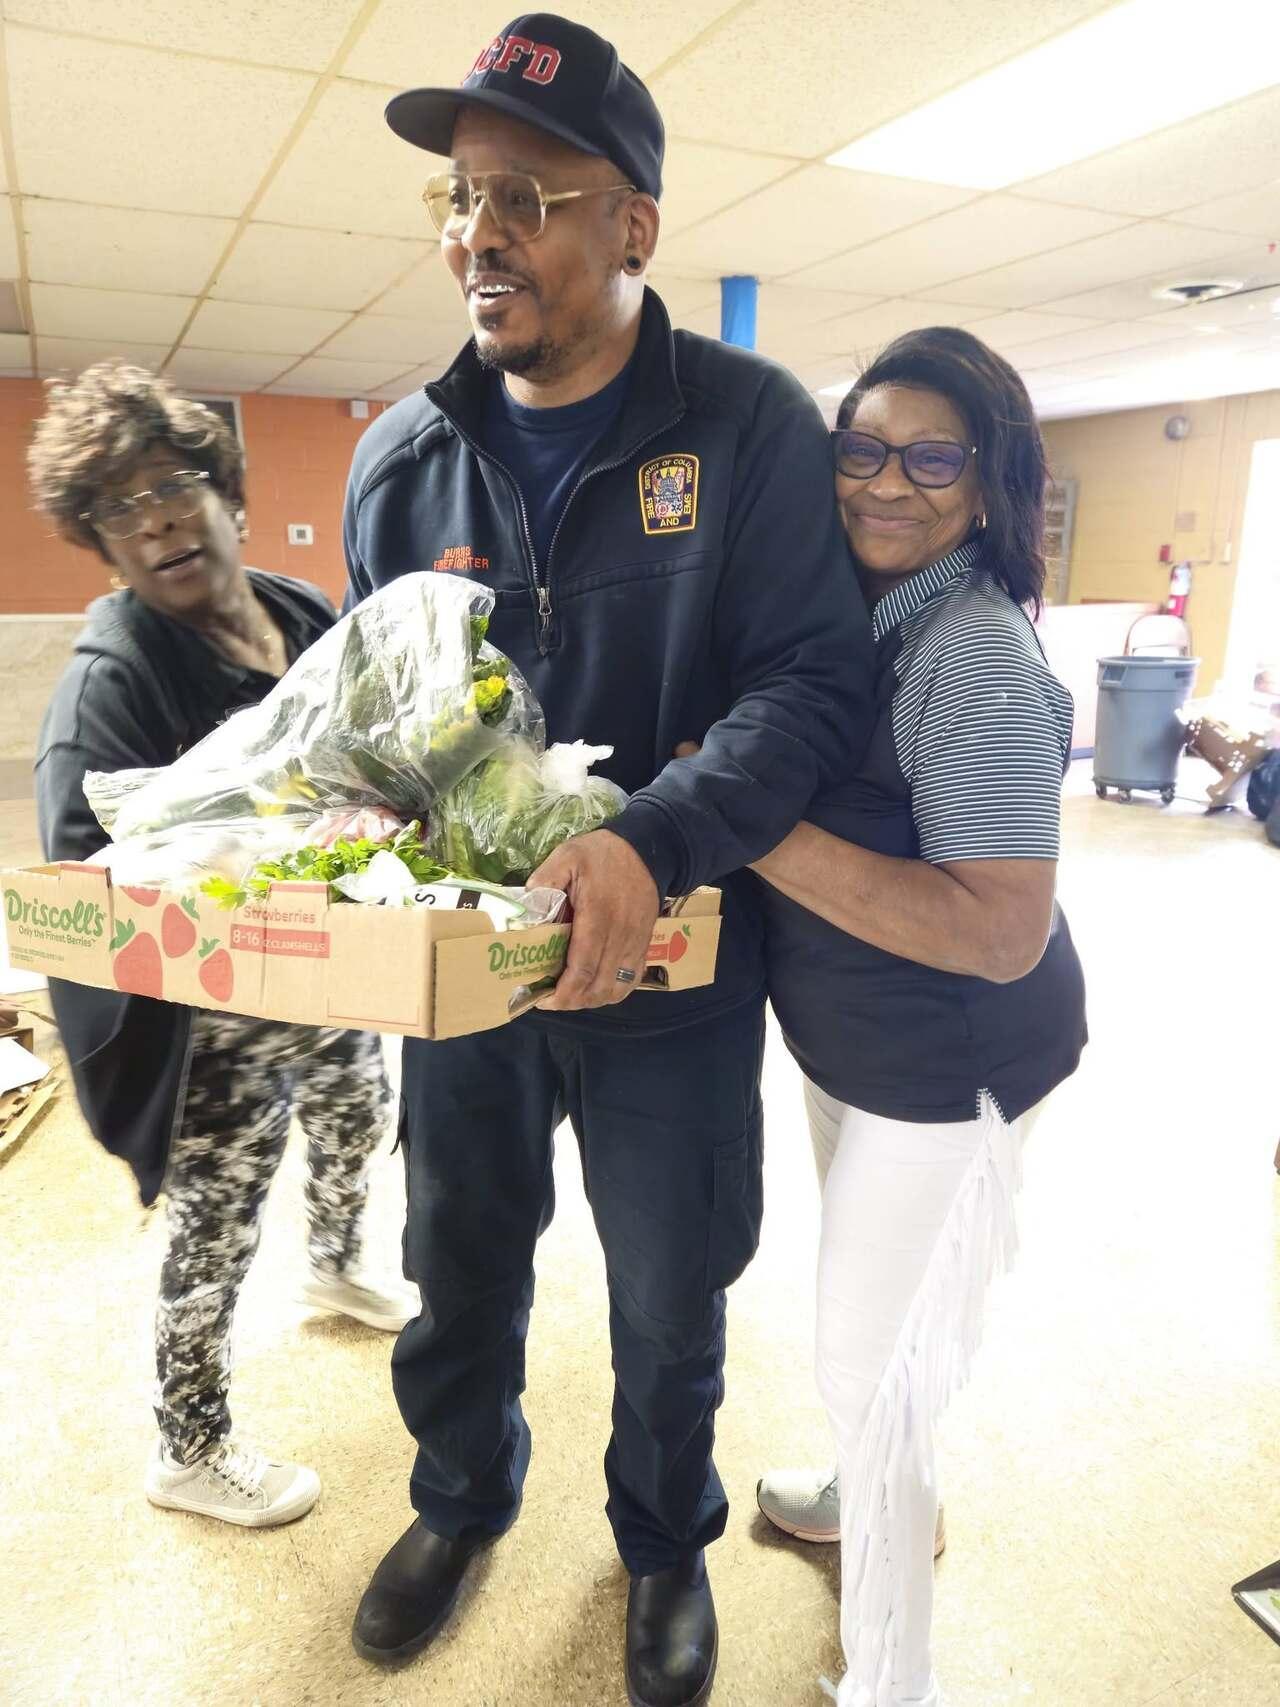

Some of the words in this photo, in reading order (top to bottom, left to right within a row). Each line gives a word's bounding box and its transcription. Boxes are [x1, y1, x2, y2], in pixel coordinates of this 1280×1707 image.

[464, 35, 561, 85] CFD
[645, 496, 656, 520] FIRE
[660, 517, 680, 528] AND
[4, 889, 104, 937] Driscoll's
[244, 906, 316, 923] Strawberries
[232, 928, 260, 947] 8-16
